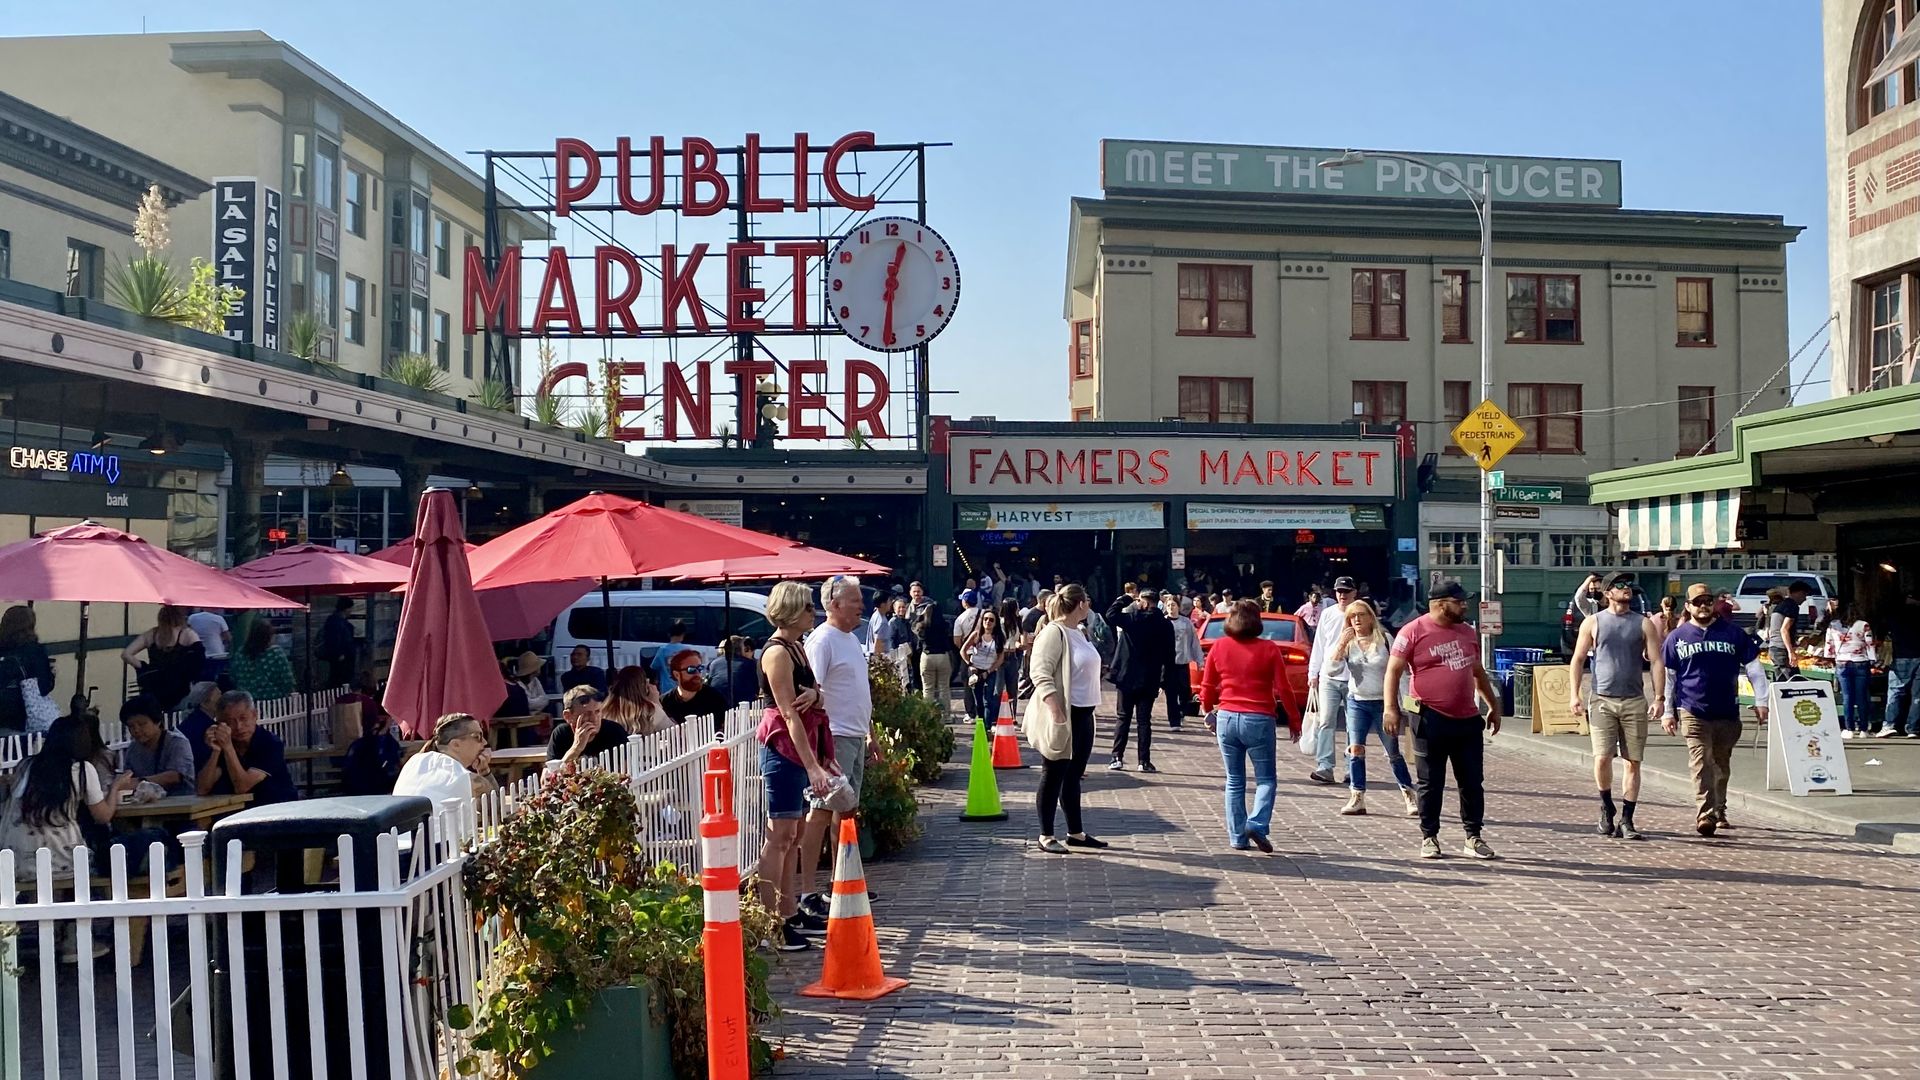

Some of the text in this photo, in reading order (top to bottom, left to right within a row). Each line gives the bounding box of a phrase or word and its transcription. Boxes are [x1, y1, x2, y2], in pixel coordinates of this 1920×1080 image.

[556, 131, 875, 217] PUBLIC
[1125, 148, 1604, 199] MEET THE PRODUCER
[885, 223, 899, 236] 12
[859, 231, 870, 244] 11
[839, 251, 853, 264] 10
[935, 250, 944, 263] 2
[265, 237, 278, 324] SALLE
[832, 278, 843, 291] 9
[942, 277, 951, 290] 3
[462, 242, 827, 336] MARKET
[840, 305, 850, 319] 8
[933, 304, 944, 317] 4
[860, 326, 870, 338] 7
[916, 325, 925, 337] 5
[1476, 411, 1501, 420] YIELD
[1483, 421, 1493, 429] TO
[1459, 431, 1516, 439] PEDESTRIANS
[10, 446, 104, 475] CHASE ATM
[969, 448, 1381, 487] FARMERS MARKET
[106, 492, 128, 507] bank
[1499, 487, 1525, 500] Pike
[996, 509, 1158, 524] HARVEST FESTIVAL
[1676, 640, 1736, 660] MARINERS
